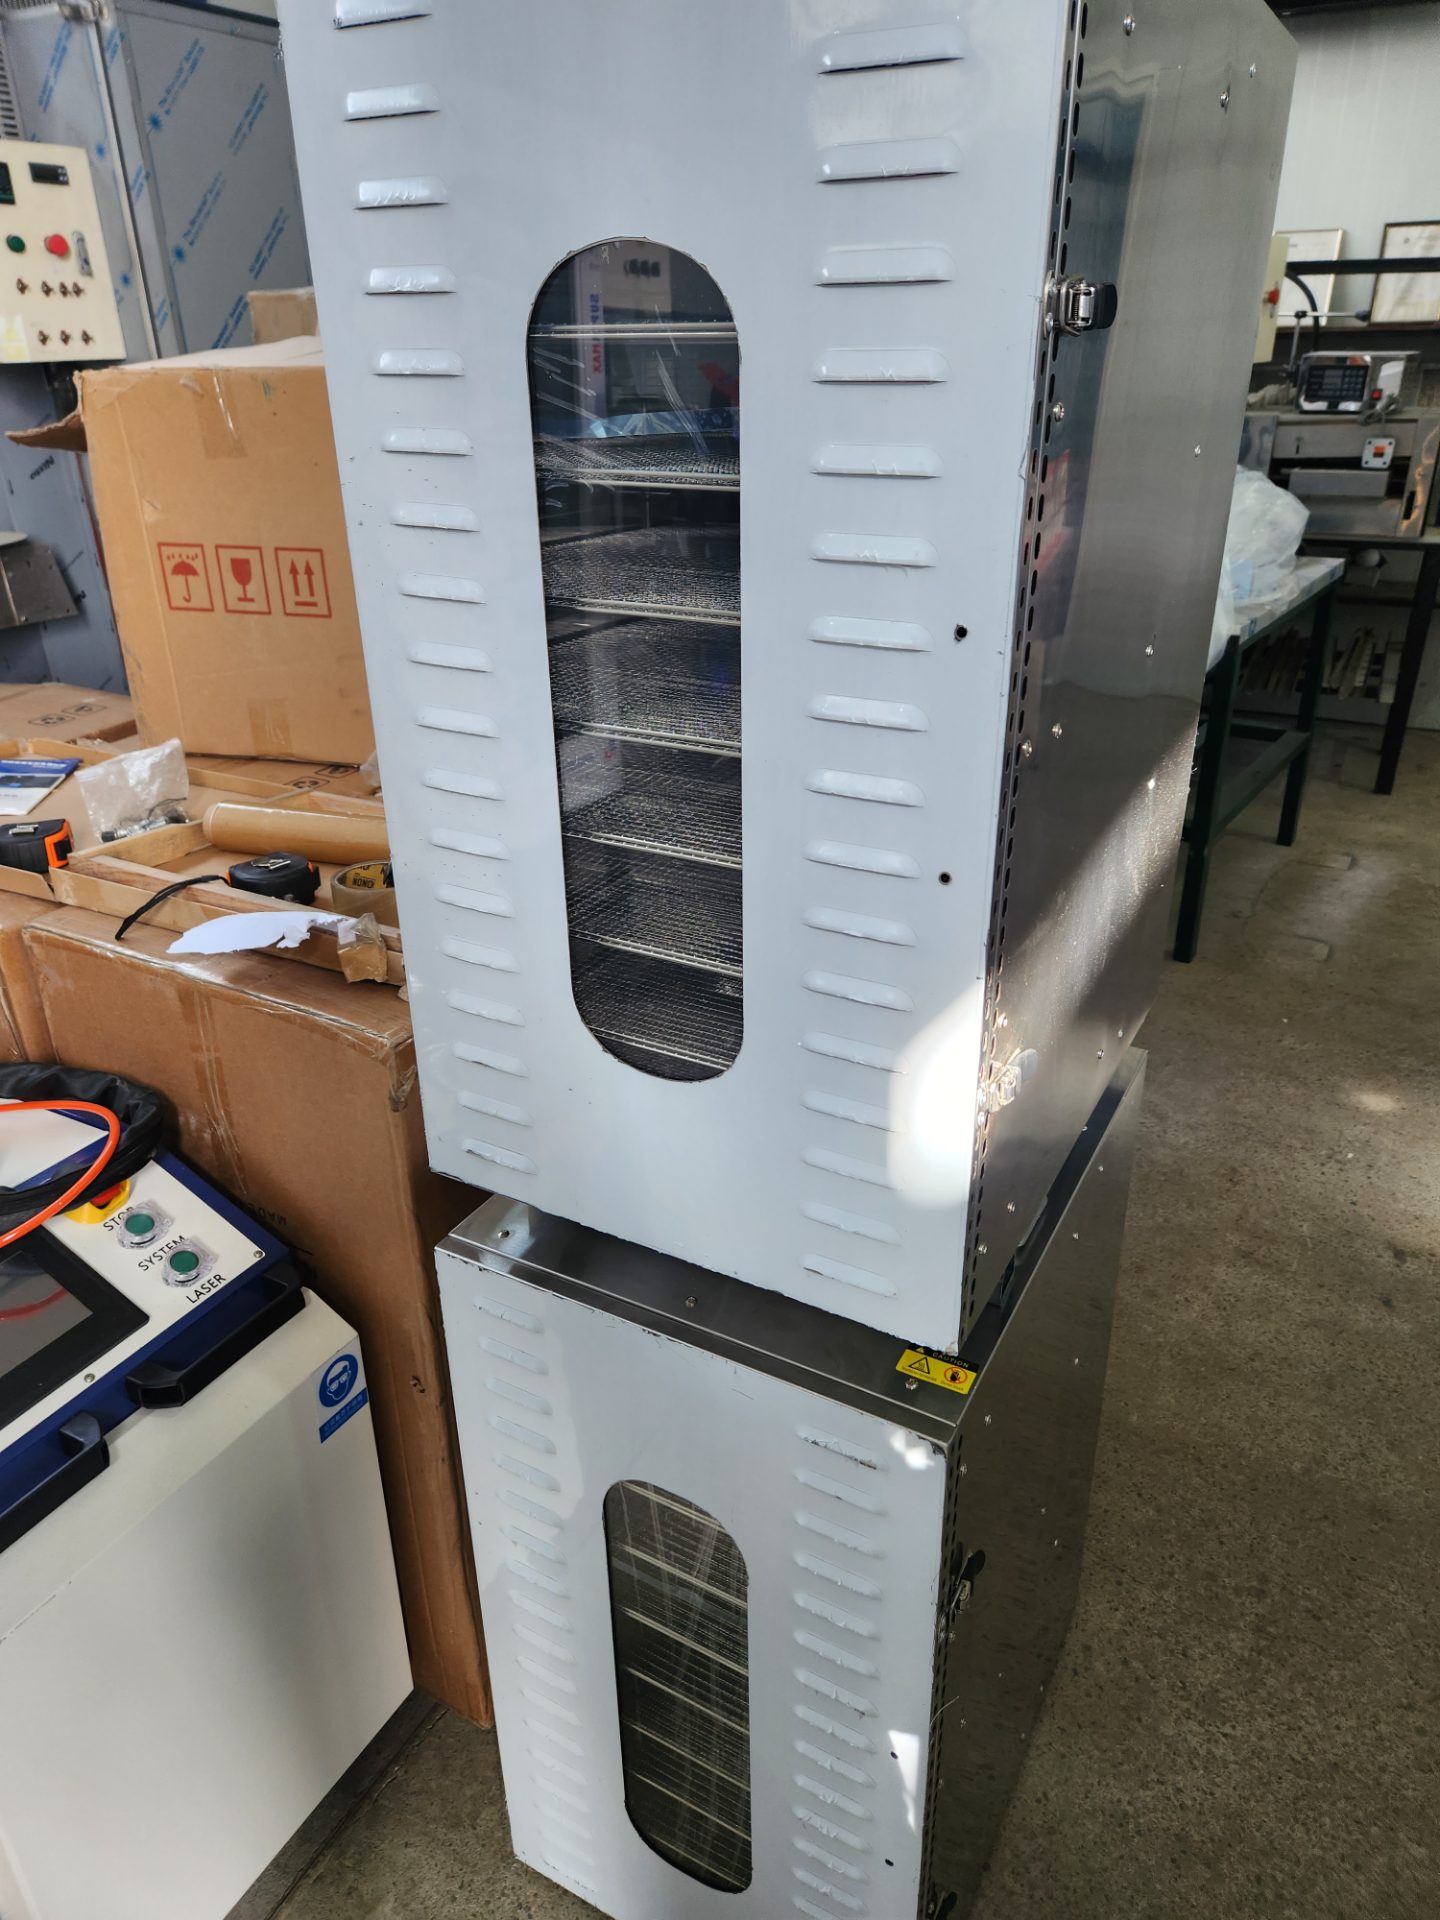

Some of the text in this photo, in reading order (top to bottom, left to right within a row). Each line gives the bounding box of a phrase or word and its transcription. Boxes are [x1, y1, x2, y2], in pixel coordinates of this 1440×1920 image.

[137, 1234, 186, 1272] SYSTEM
[186, 1273, 227, 1304] LASER
[932, 1351, 969, 1368] CAUTION
